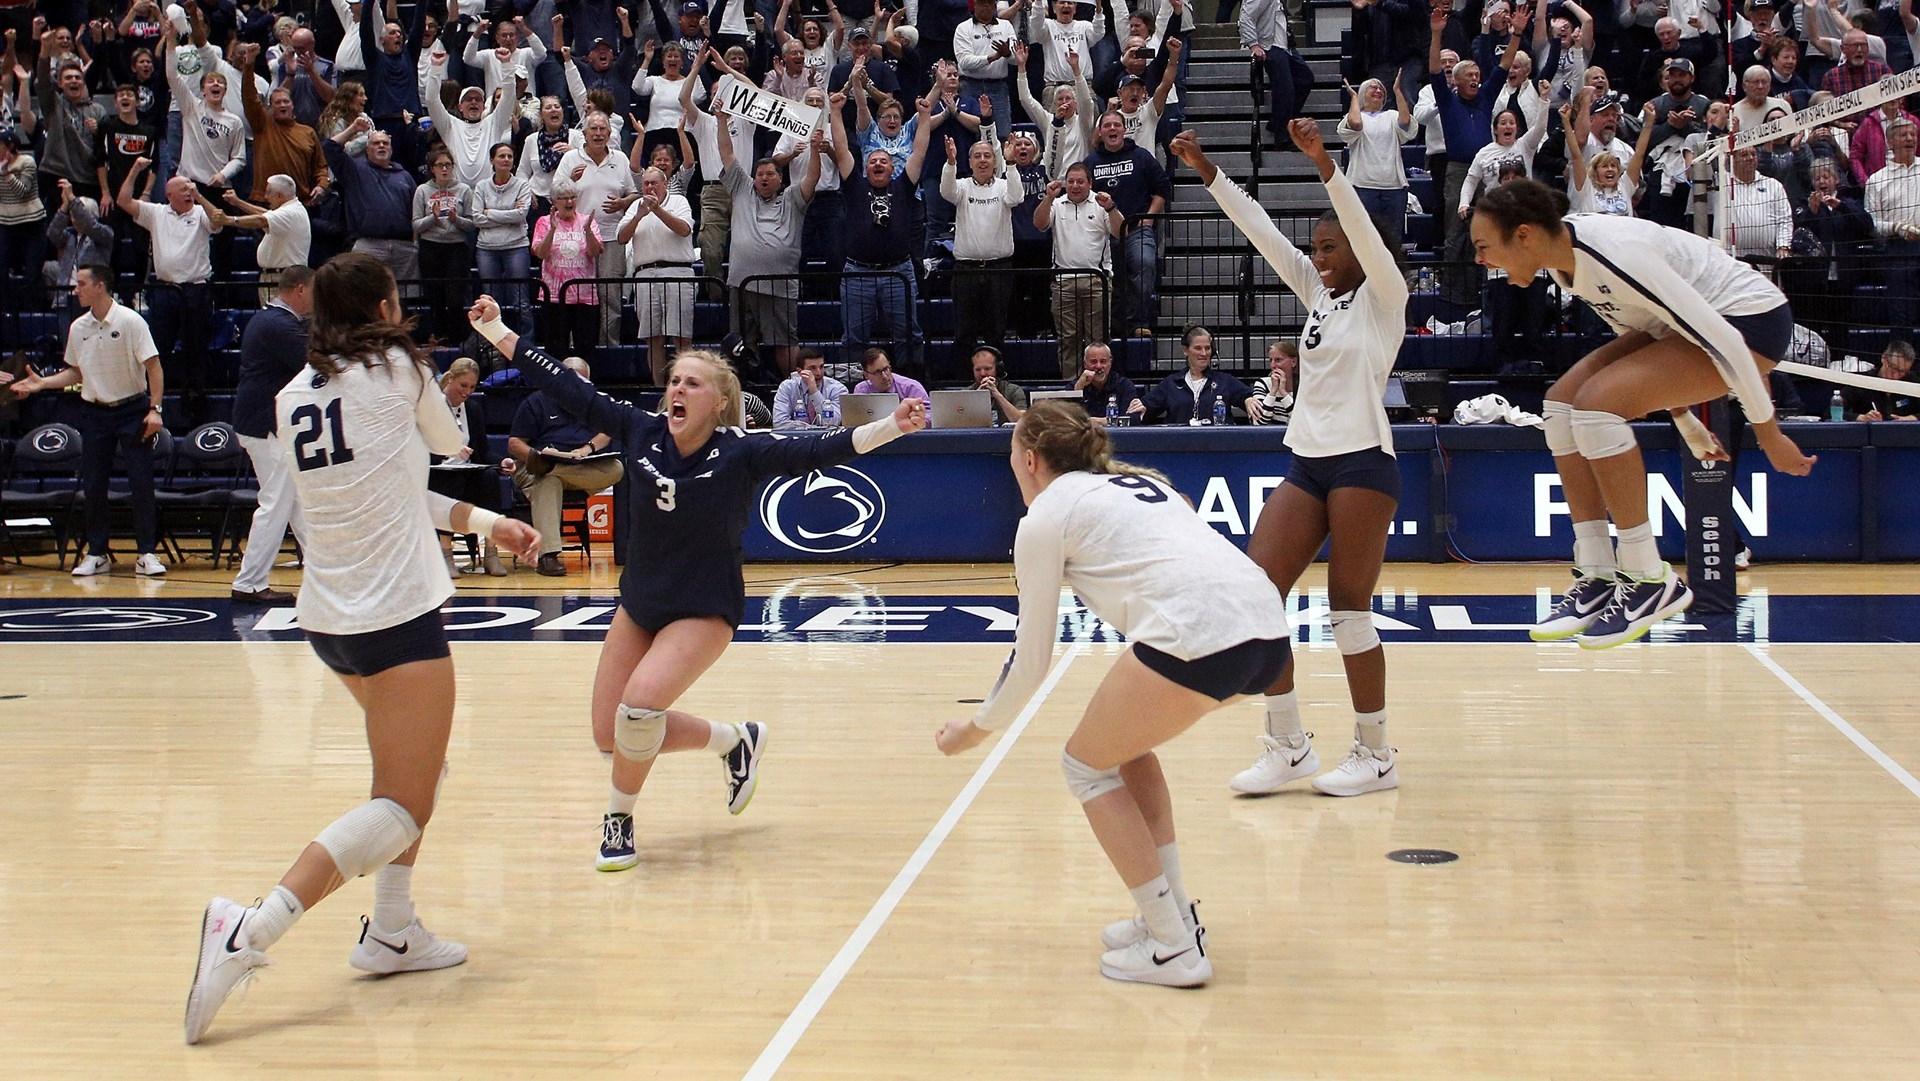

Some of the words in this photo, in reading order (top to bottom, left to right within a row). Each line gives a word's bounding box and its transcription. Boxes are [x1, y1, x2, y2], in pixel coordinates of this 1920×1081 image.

[1880, 77, 1899, 97] PENN
[1093, 162, 1134, 178] UNRIVALED
[1305, 325, 1321, 350] 5
[291, 397, 354, 472] 21
[656, 478, 677, 512] 3
[1108, 475, 1168, 503] 9
[587, 503, 609, 528] G
[1534, 472, 1768, 537] PNN
[1701, 516, 1721, 580] senoh
